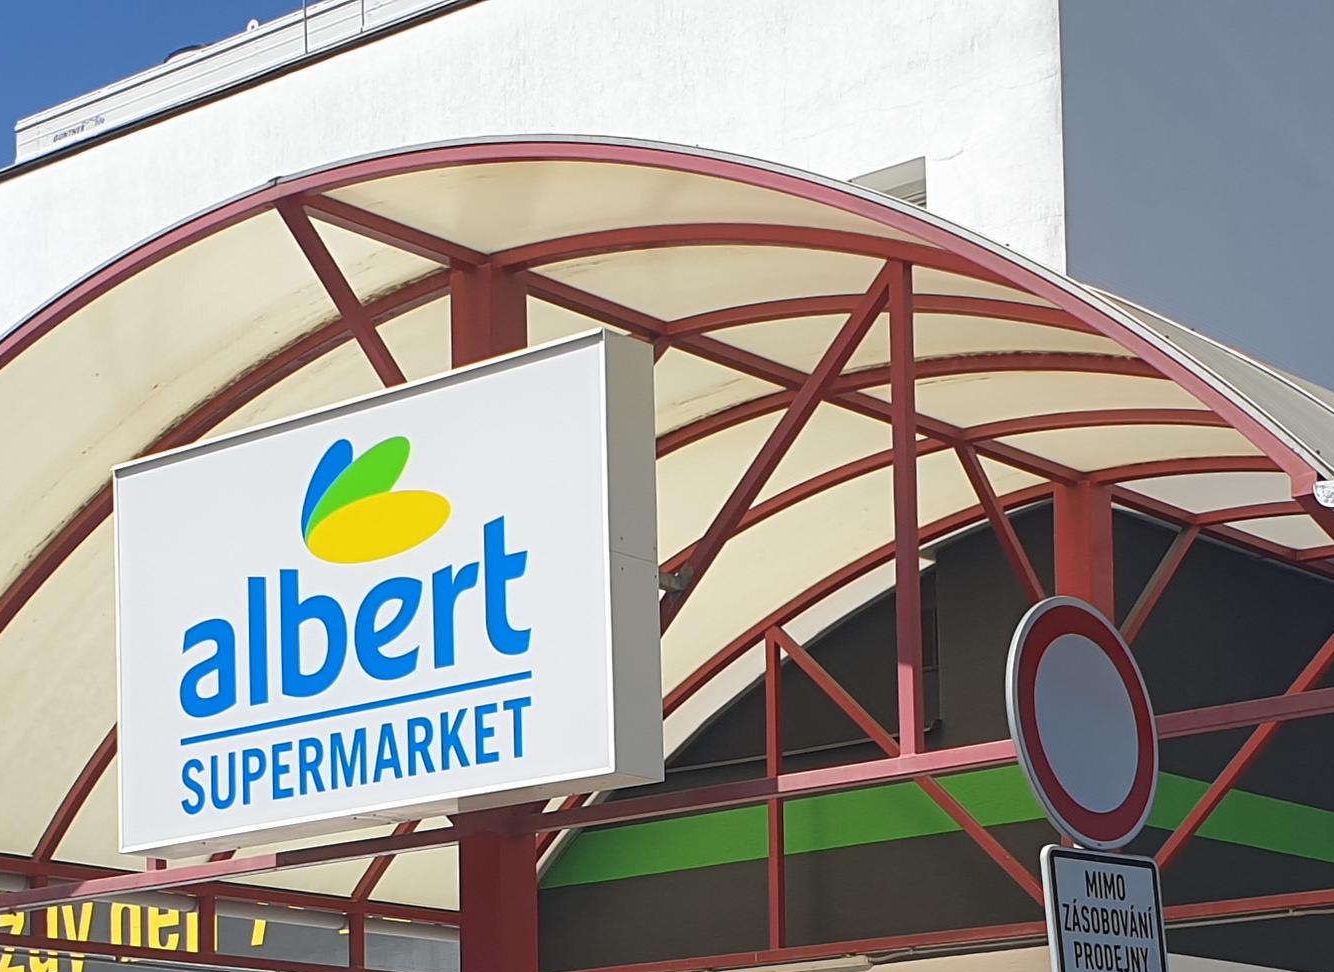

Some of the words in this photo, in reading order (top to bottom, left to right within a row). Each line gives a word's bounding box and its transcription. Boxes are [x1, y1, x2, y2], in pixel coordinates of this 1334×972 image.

[179, 515, 532, 718] albert
[181, 696, 532, 816] SUPERMARKET
[1062, 899, 1154, 939] ZÁSOBOVÁNÍ
[1085, 870, 1126, 900] MIMO
